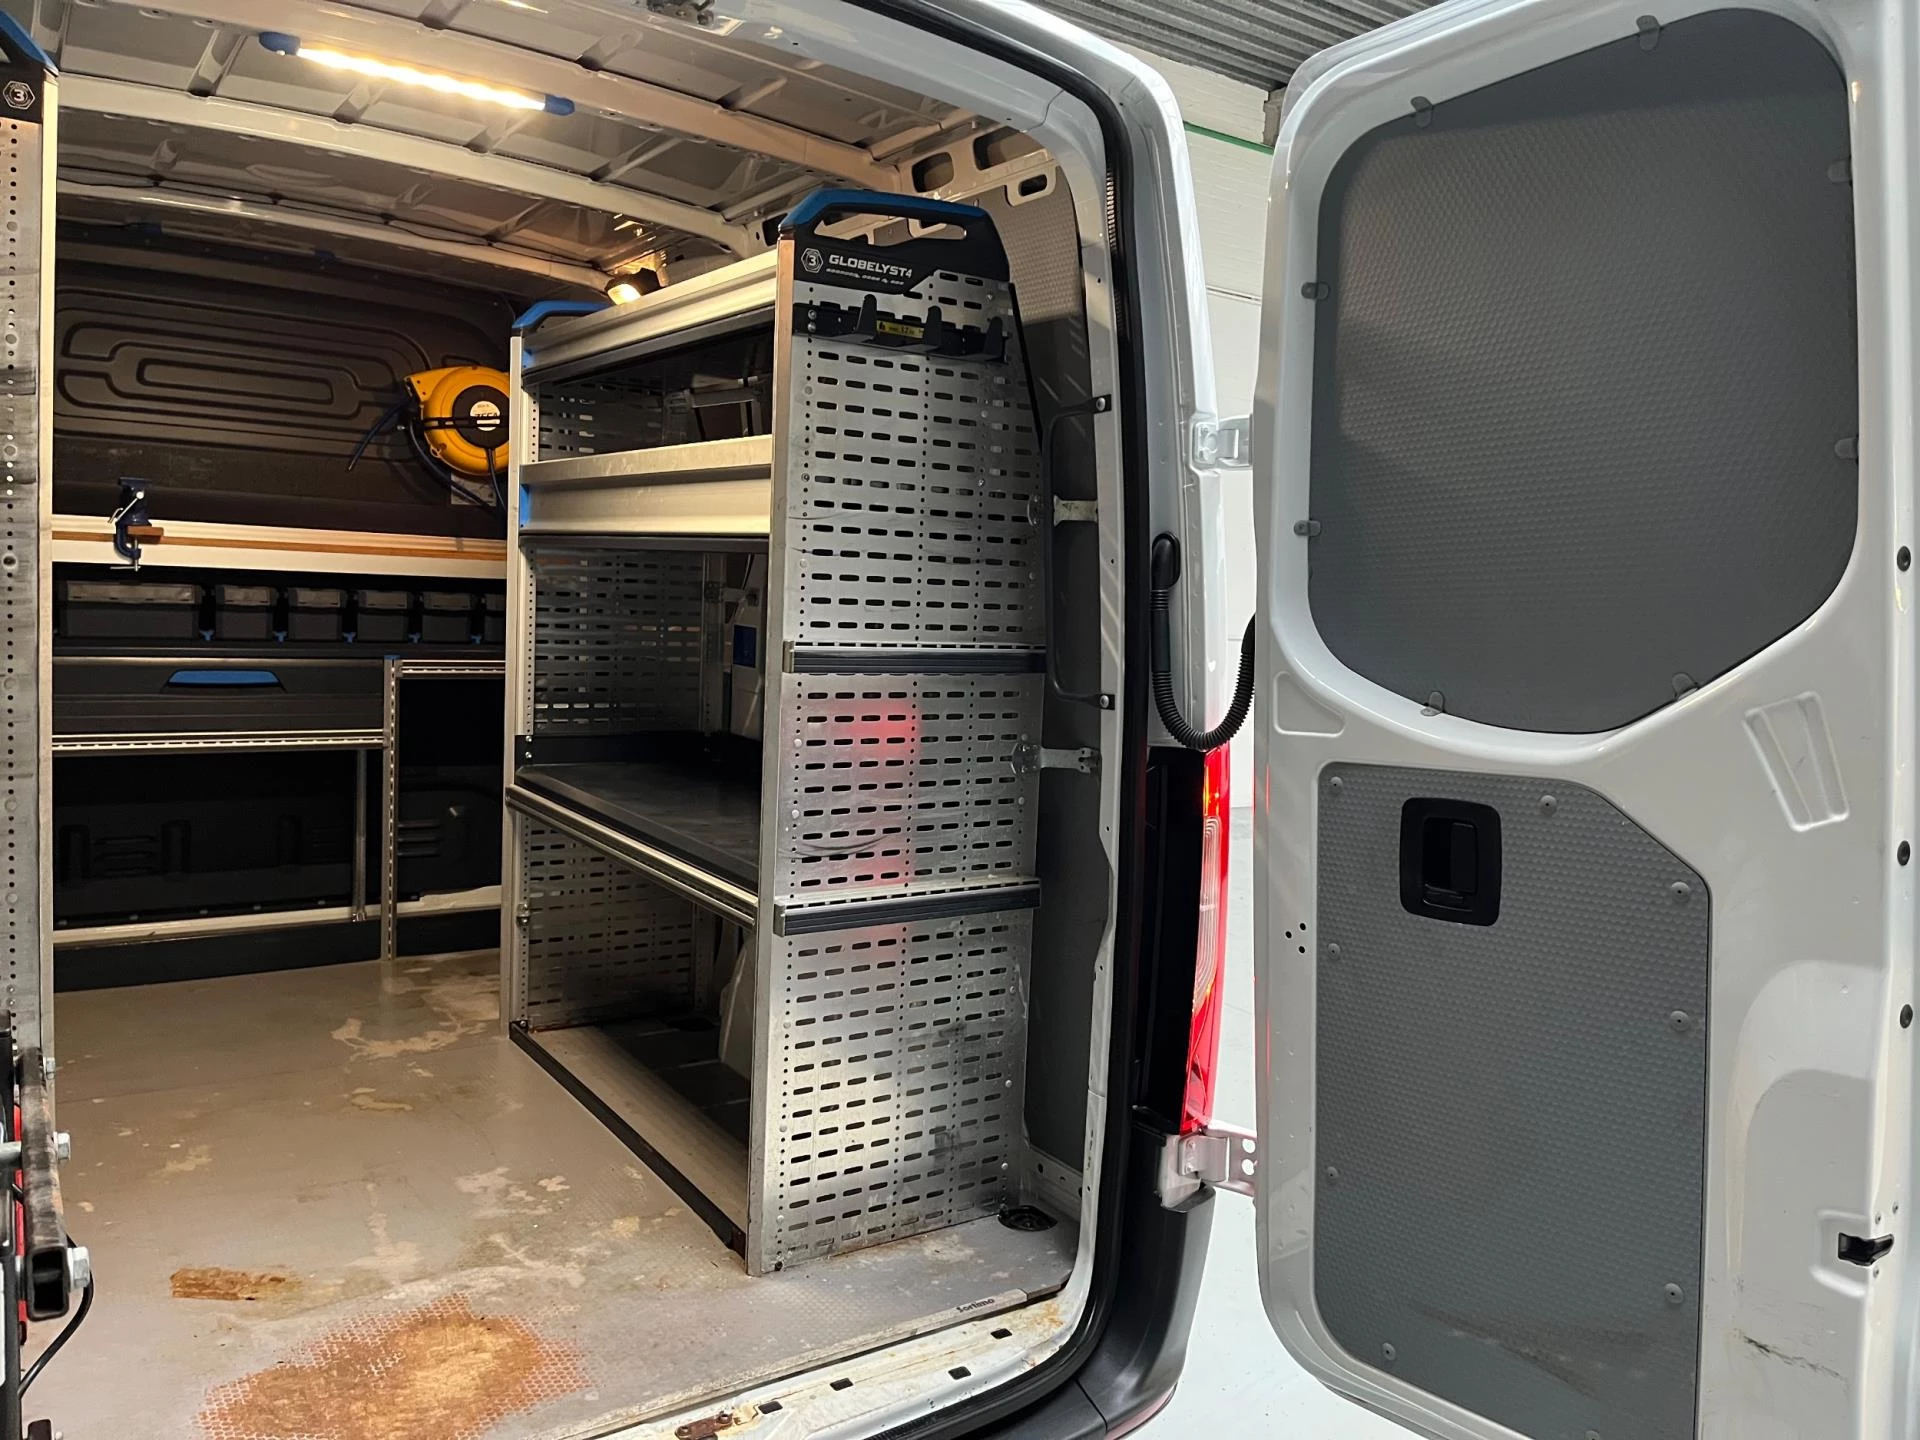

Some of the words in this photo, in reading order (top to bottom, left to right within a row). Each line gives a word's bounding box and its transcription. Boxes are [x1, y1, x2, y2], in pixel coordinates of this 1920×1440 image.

[13, 89, 25, 102] 3
[808, 254, 817, 267] 3
[829, 254, 913, 278] GLOBELYST4
